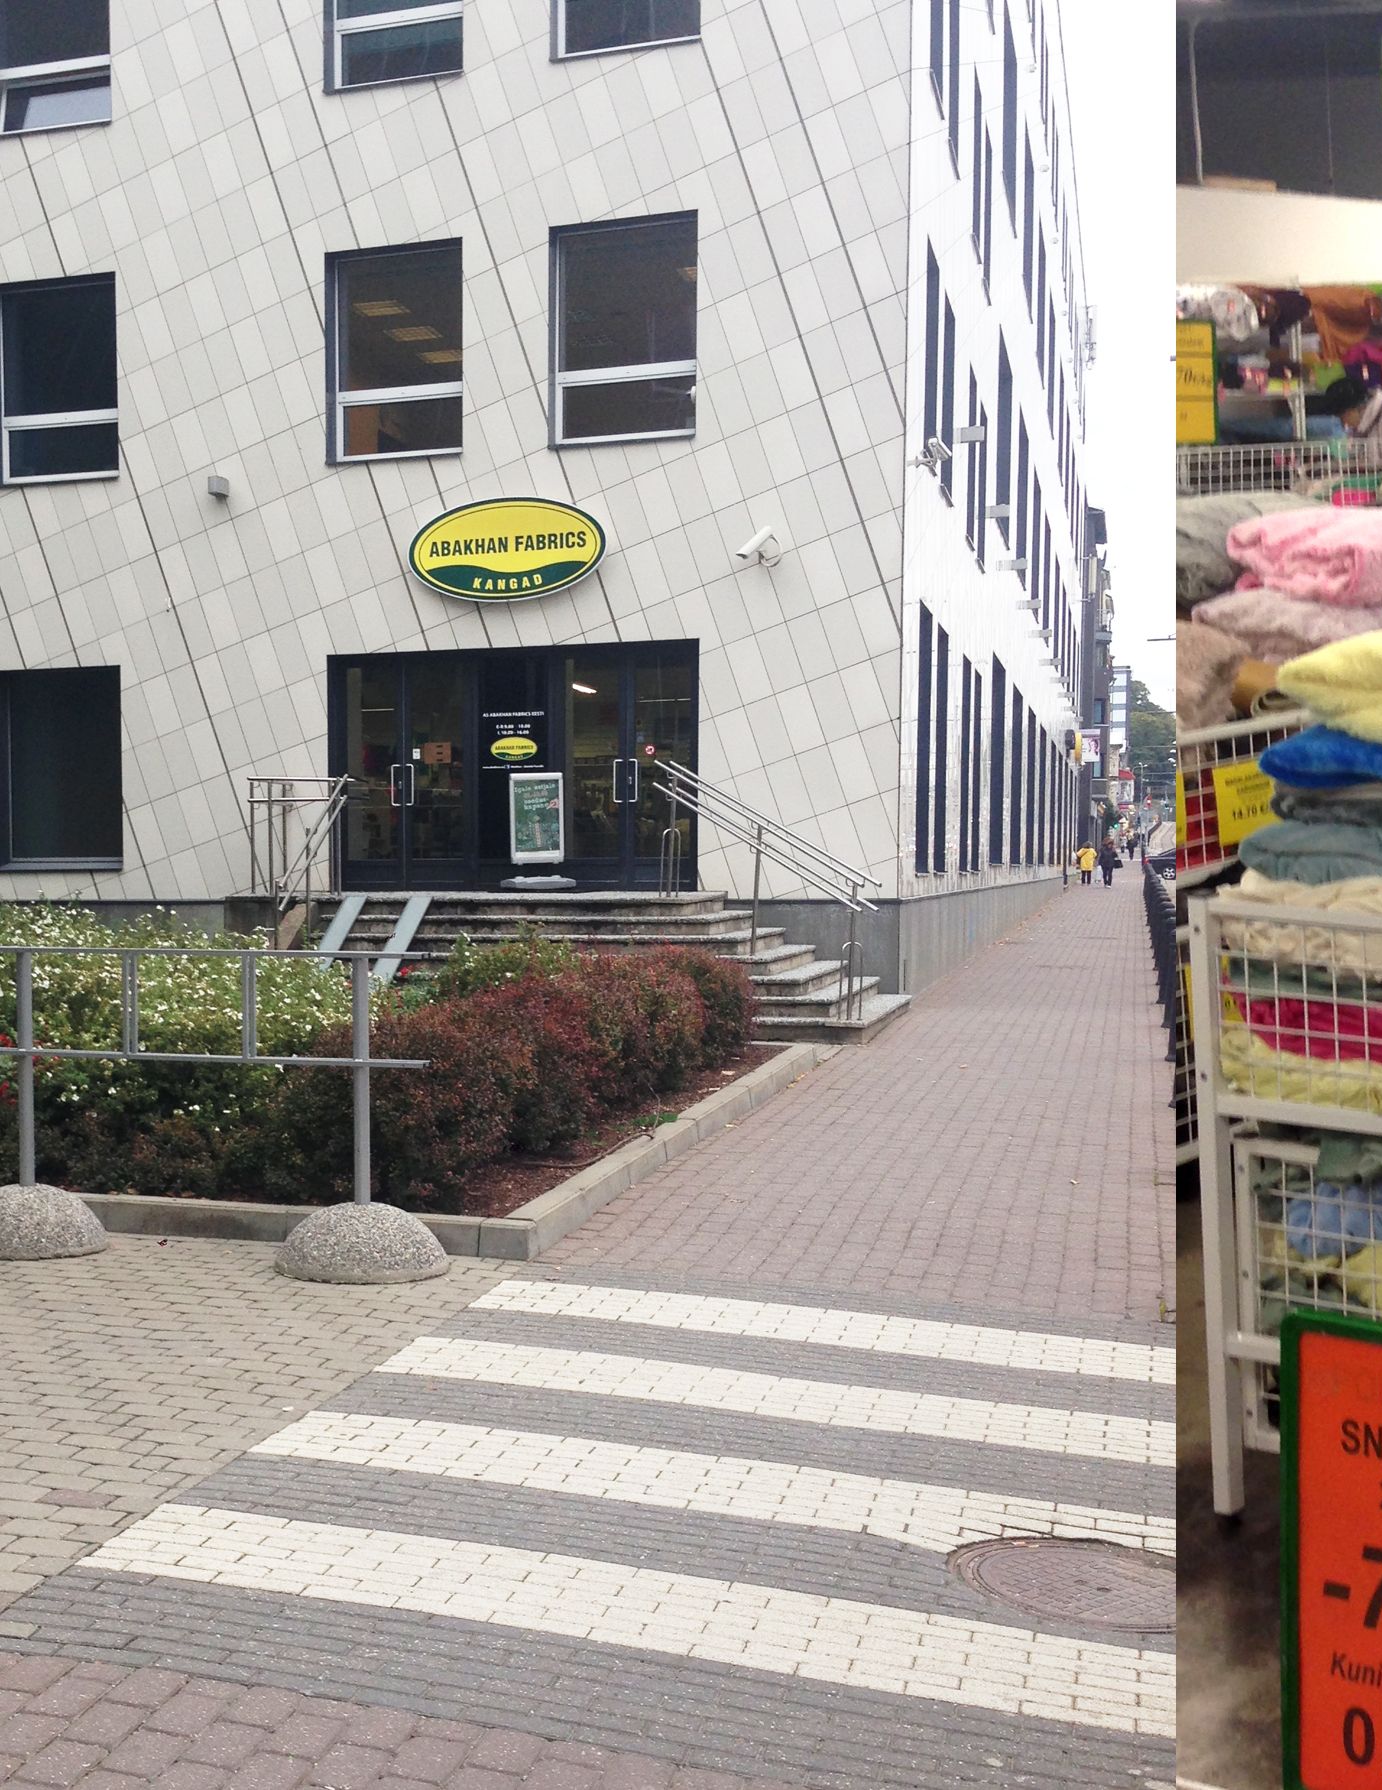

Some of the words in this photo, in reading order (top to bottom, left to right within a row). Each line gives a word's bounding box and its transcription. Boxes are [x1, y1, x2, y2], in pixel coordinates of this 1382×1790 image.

[429, 536, 509, 558] ABAKHAN
[514, 530, 587, 552] FABRICS
[472, 573, 543, 590] KANGAD
